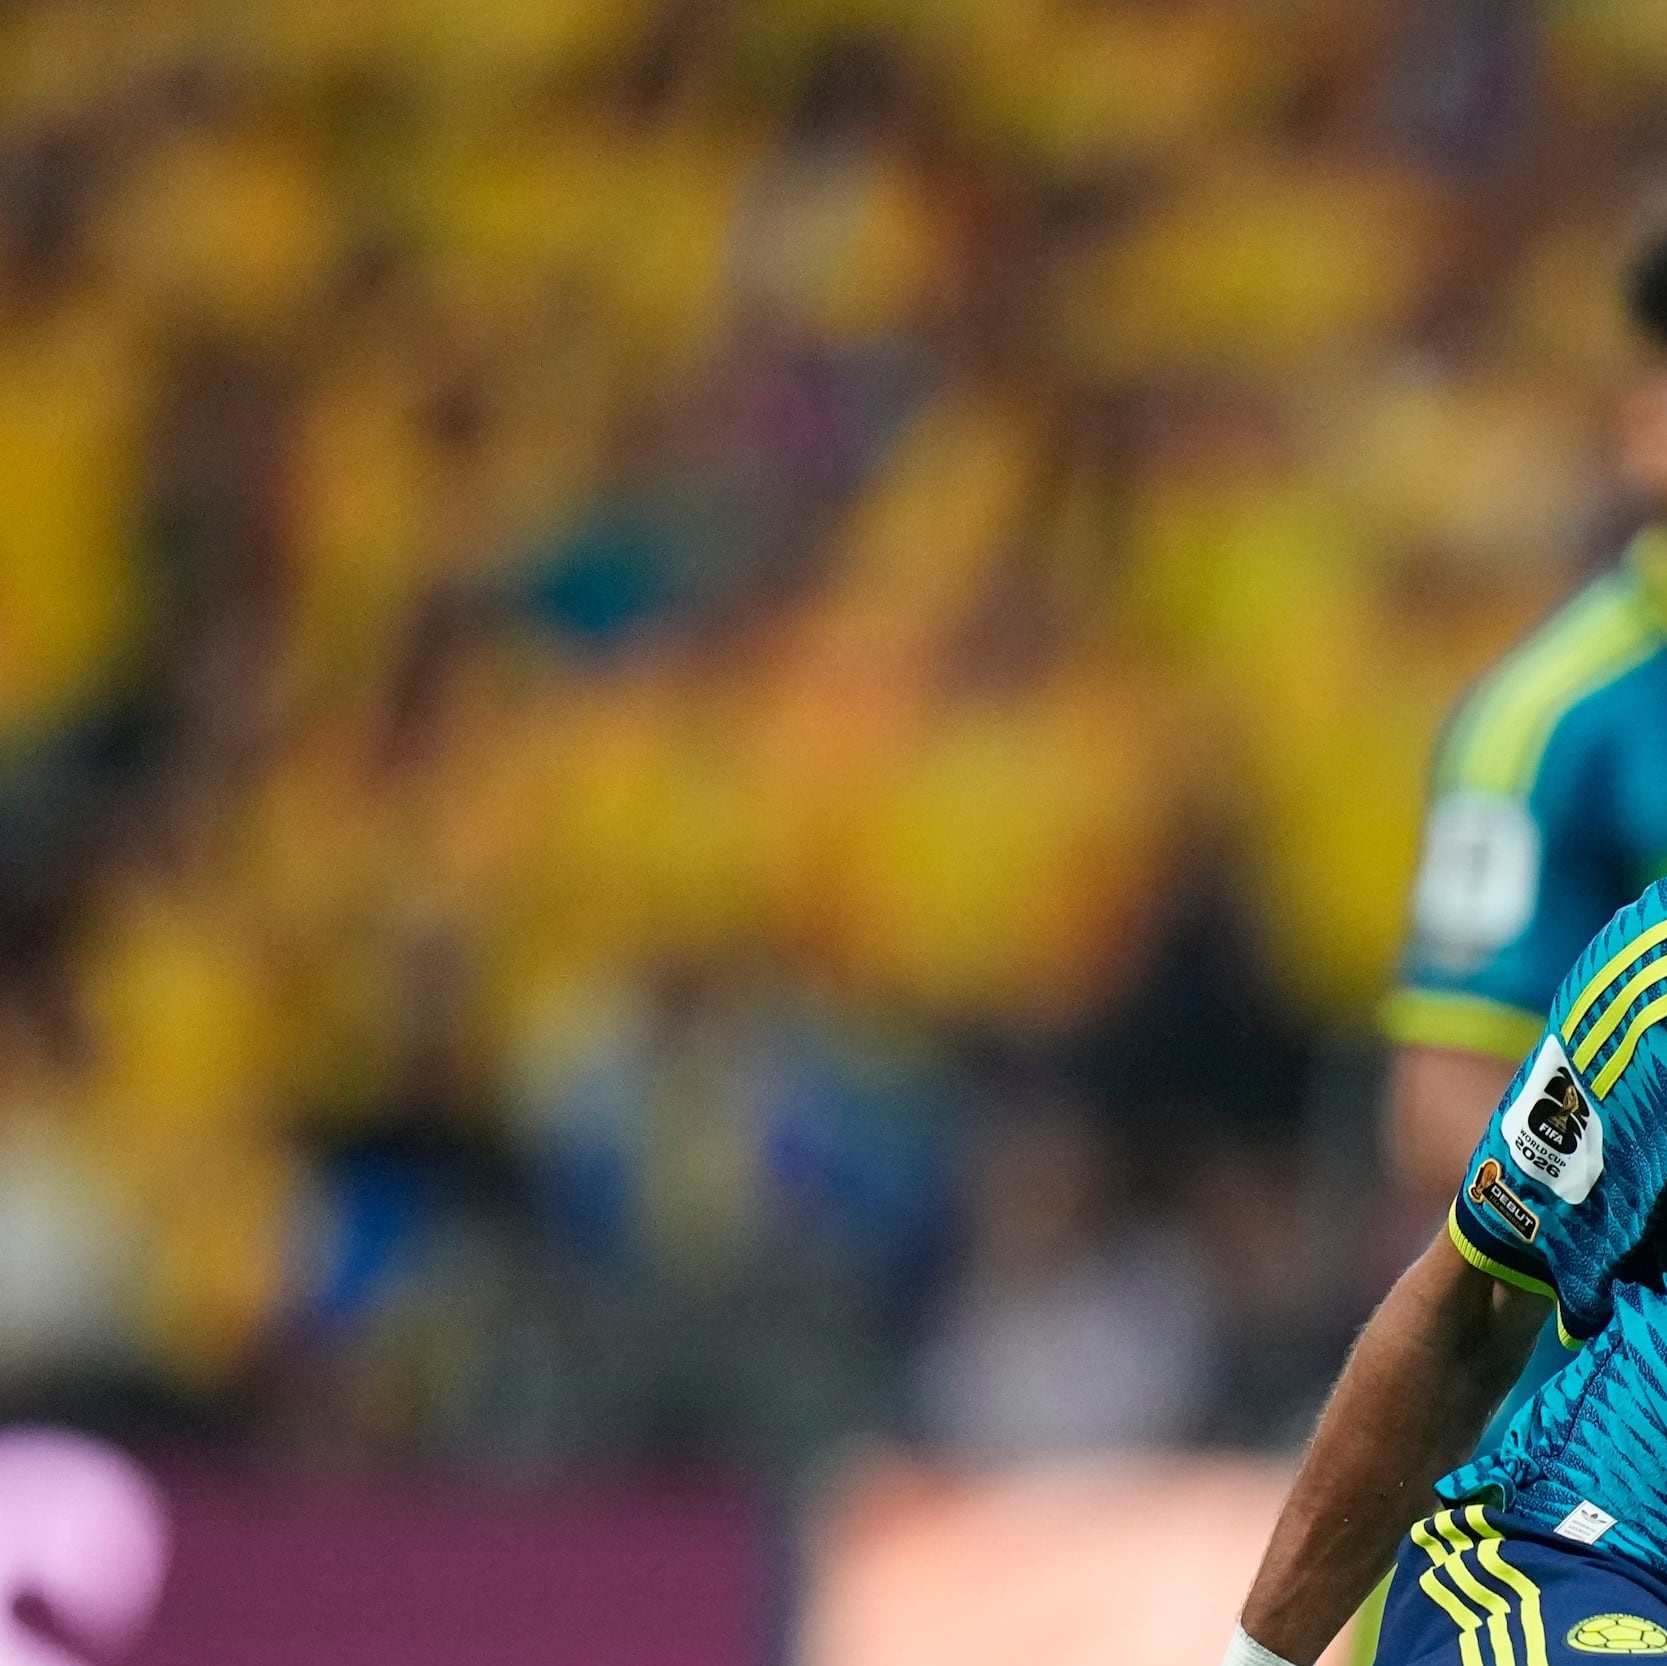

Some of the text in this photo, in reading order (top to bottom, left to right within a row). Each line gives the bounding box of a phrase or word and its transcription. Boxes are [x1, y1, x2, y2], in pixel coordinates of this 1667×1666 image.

[1520, 1128, 1567, 1168] WORLD CUP
[1538, 1122, 1564, 1146] FIFA
[1515, 1135, 1561, 1179] 2026
[1490, 1184, 1534, 1227] DEBUT
